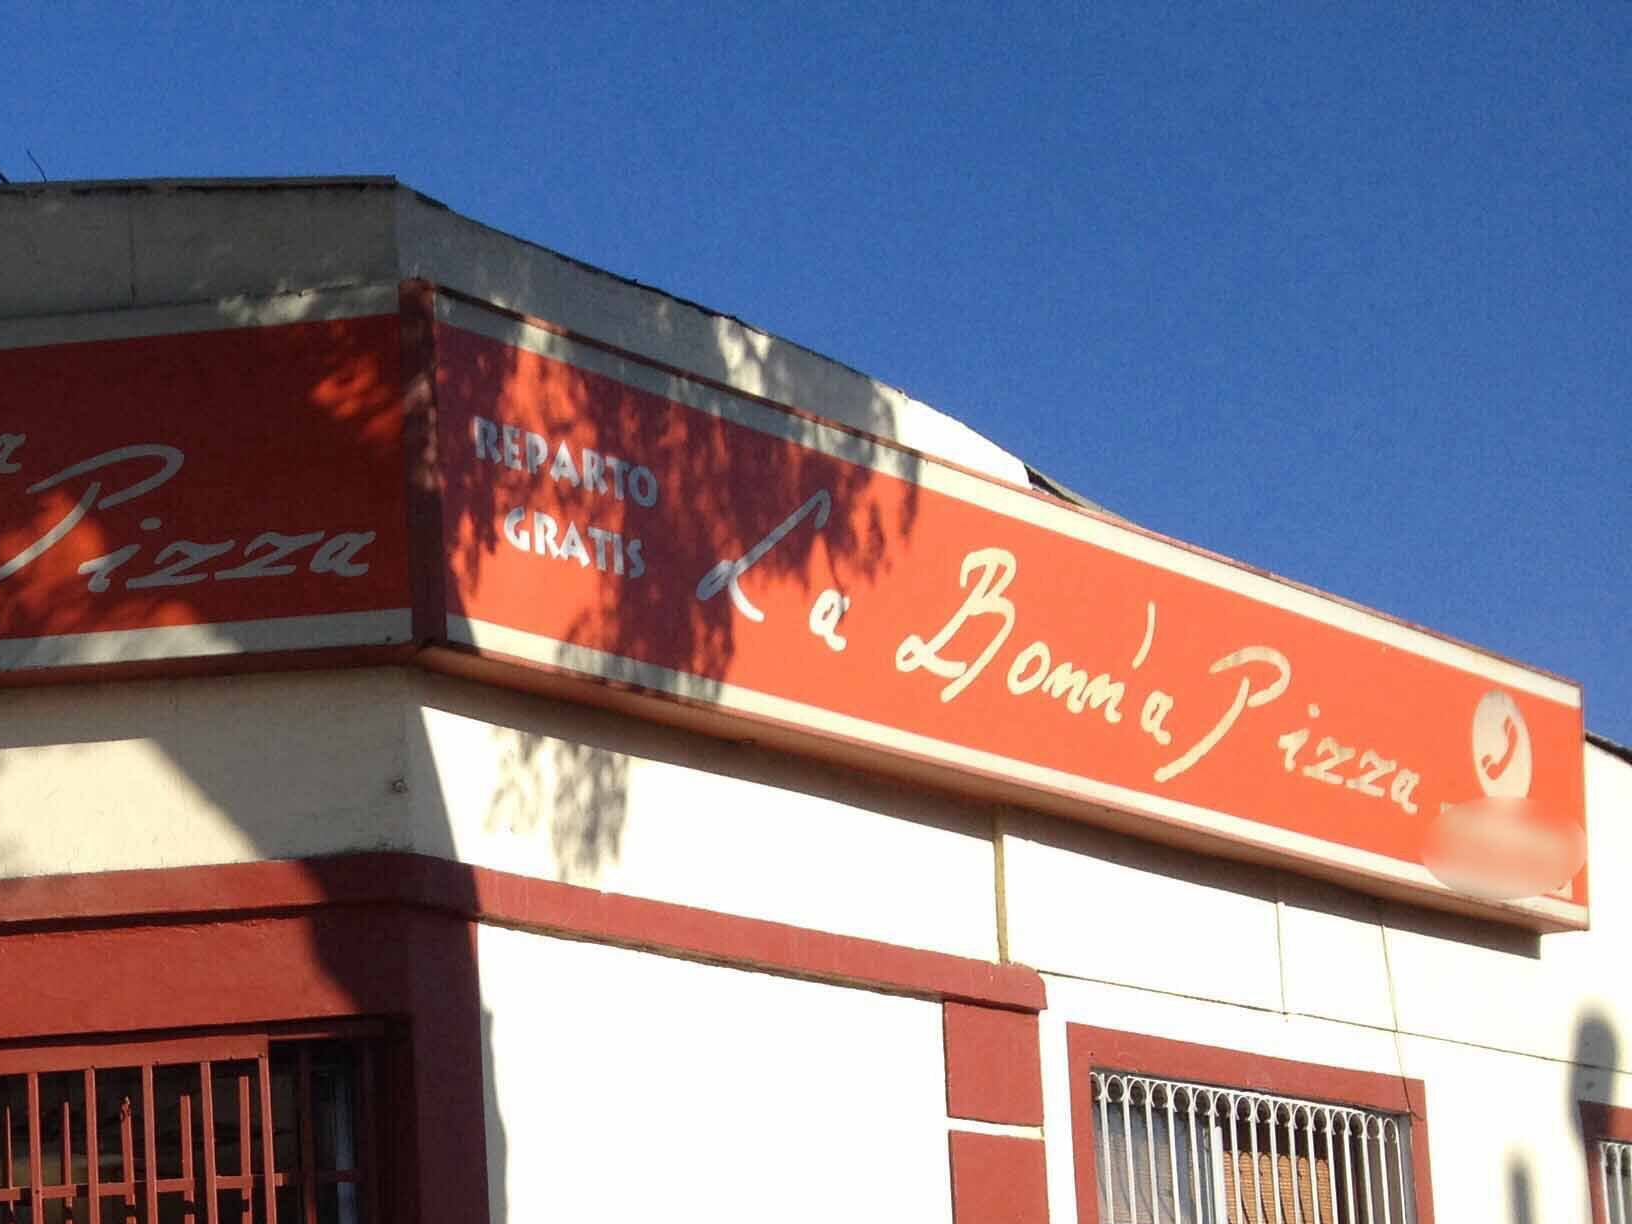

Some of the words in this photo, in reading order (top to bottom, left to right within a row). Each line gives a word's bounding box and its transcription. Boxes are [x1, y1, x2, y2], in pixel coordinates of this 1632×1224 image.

[473, 416, 658, 508] REPARTO
[503, 506, 646, 579] GRATIS
[696, 488, 850, 651] La
[1153, 645, 1420, 814] Pizza
